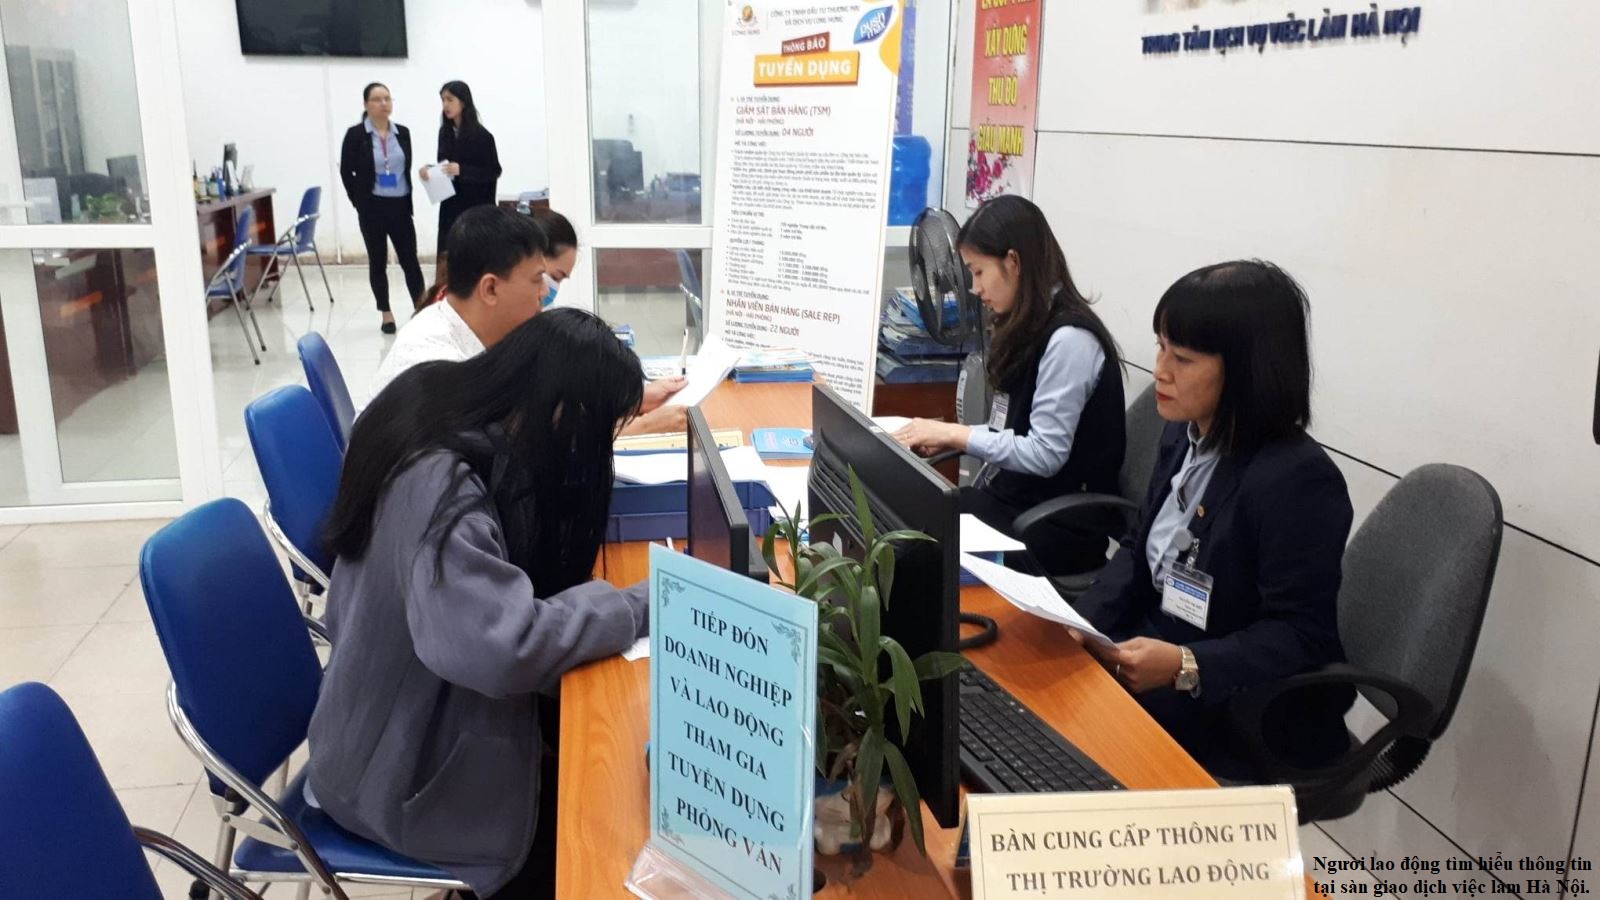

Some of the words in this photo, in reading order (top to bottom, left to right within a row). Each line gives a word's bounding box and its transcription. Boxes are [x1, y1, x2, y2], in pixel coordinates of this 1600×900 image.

[783, 40, 806, 53] THÔNG
[806, 36, 826, 50] BÁO
[1182, 24, 1211, 51] TÂM
[1212, 25, 1245, 57] DỊCH
[1246, 23, 1269, 54] VỤ
[1307, 8, 1348, 41] LÀM
[1350, 2, 1380, 38] HÀ
[758, 57, 804, 78] TUYỂN
[808, 60, 851, 80] DỤNG
[736, 104, 754, 115] GIÁM
[756, 104, 770, 115] SÁT
[771, 104, 786, 116] BÁN
[788, 104, 808, 116] HÀNG
[810, 106, 832, 117] (TSM)
[782, 128, 791, 136] 04
[792, 126, 814, 136] NGƯỜI
[726, 298, 746, 309] NHÂN
[748, 300, 764, 312] VIÊN
[765, 302, 780, 314] BÁN
[780, 304, 800, 317] HÀNG
[801, 309, 822, 320] (SALE
[822, 312, 841, 325] REP)
[770, 324, 778, 334] 22
[779, 325, 800, 336] NGƯỜI
[690, 606, 728, 636] TIẾP
[731, 625, 769, 657] ĐÓN
[664, 634, 721, 676] DOANH
[724, 662, 793, 708] NGHIỆP
[670, 675, 692, 702] VÀ
[695, 690, 730, 720] LAO
[734, 711, 784, 748] ĐỘNG
[683, 719, 732, 761] THAM
[736, 749, 768, 780] GIA
[667, 750, 726, 800] TUYỂN
[731, 786, 785, 833] DỤNG
[675, 796, 737, 849] PHỎNG
[743, 834, 782, 877] VẤN
[990, 828, 1037, 853] BÀN
[1043, 830, 1103, 851] CUNG
[1109, 821, 1151, 849] CẤP
[1156, 821, 1235, 846] THÔNG
[1239, 822, 1278, 843] TIN
[1006, 871, 1047, 895] THỊ
[1052, 863, 1151, 890] TRƯỜNG
[1158, 865, 1201, 886] LAO
[1206, 858, 1270, 887] ĐỘNG
